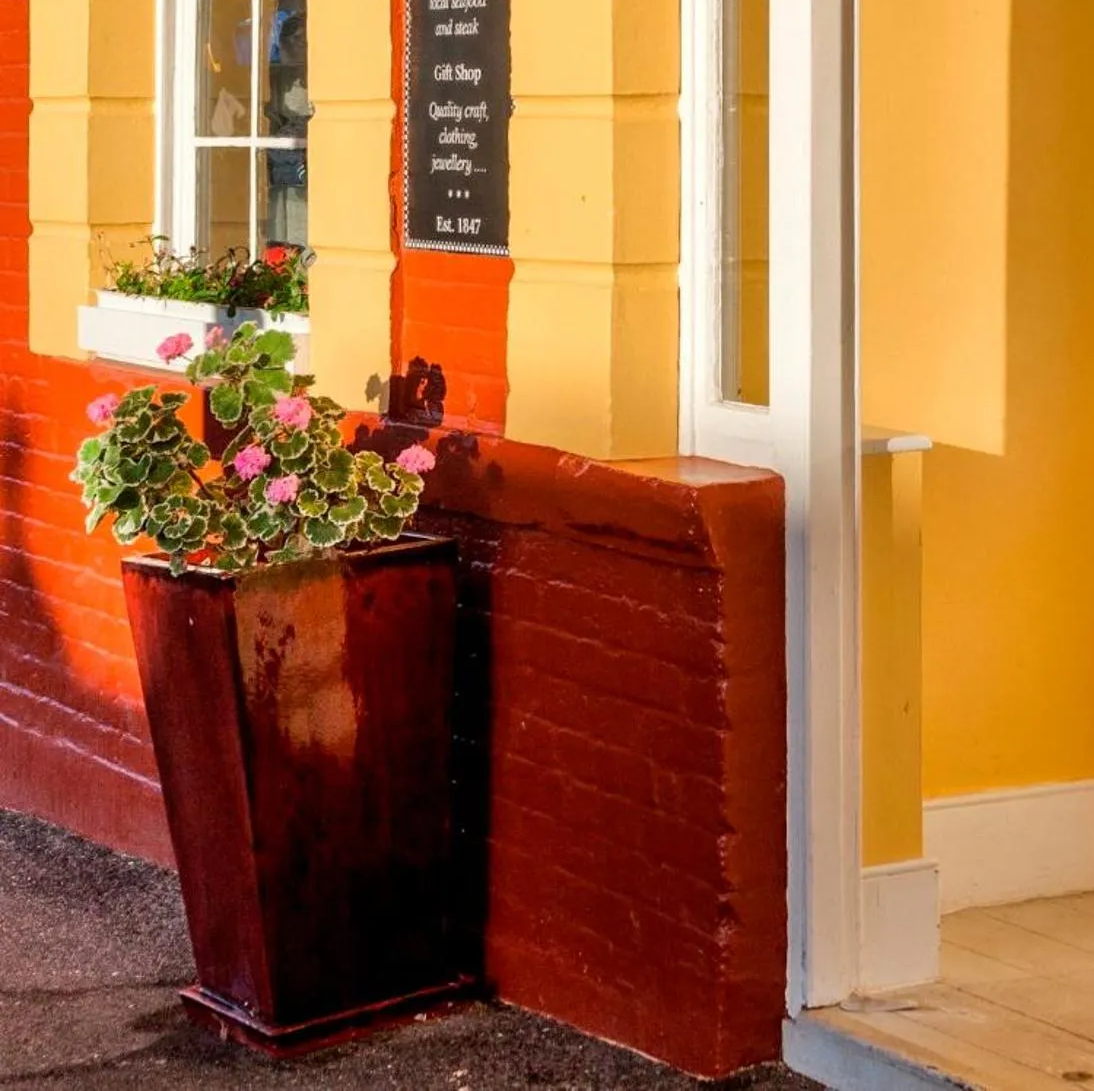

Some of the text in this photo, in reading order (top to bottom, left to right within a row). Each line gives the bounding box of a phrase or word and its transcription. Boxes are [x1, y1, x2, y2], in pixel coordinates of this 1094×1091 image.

[435, 17, 479, 37] and steak
[434, 63, 482, 85] Gift Shop
[429, 102, 490, 123] Quality craft,
[439, 127, 478, 149] clothing,
[431, 154, 472, 176] jewellery
[436, 216, 481, 234] Est. 1847
